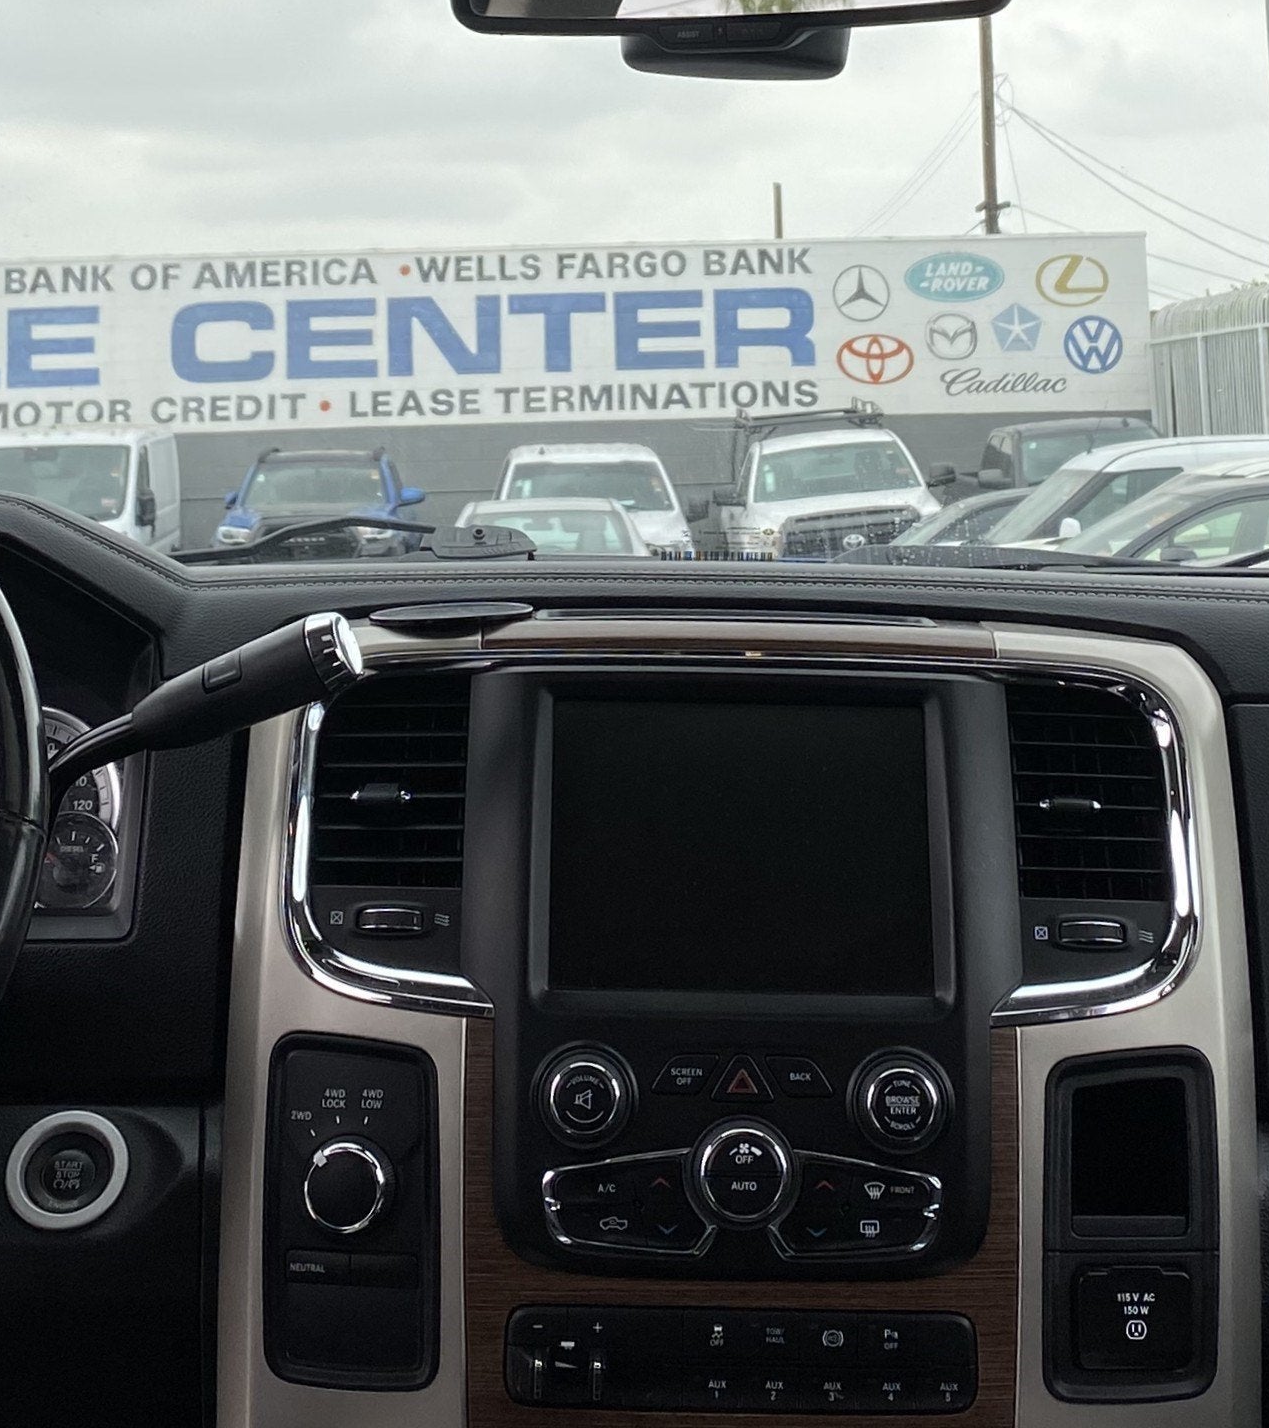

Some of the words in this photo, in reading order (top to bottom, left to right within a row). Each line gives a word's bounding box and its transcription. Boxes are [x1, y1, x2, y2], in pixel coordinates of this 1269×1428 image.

[4, 264, 115, 295] BANK
[130, 262, 183, 292] OF
[192, 257, 379, 292] AMERICA
[415, 252, 542, 285] WELLS
[556, 249, 687, 281] FARGO
[702, 246, 813, 277] BANK
[170, 286, 817, 385] CENTER
[939, 367, 1068, 397] Cadillac
[150, 392, 307, 425] CREDIT
[348, 387, 481, 419] LEASE
[494, 378, 820, 415] TERMINATIONS
[71, 799, 94, 811] 120
[670, 1067, 703, 1077] SCREEN
[789, 1072, 811, 1081] BACK
[570, 1074, 600, 1085] VOLUME
[676, 1077, 693, 1086] OFF
[892, 1080, 911, 1088] TUNE
[324, 1088, 346, 1098] 4WD
[362, 1088, 384, 1099] 4WD
[321, 1098, 346, 1109] LOCK
[361, 1099, 383, 1109] LOW
[885, 1095, 920, 1104] BROWSE
[290, 1110, 312, 1121] 2WD
[890, 1106, 917, 1115] ENTER
[890, 1120, 916, 1131] SCROLL
[735, 1154, 754, 1164] OFF
[54, 1160, 83, 1169] START
[55, 1170, 80, 1179] STOP
[597, 1183, 617, 1193] A/C
[730, 1181, 757, 1191] AUTO
[289, 1262, 326, 1274] NEUTRAL
[1117, 1292, 1131, 1302] 115
[1143, 1292, 1156, 1302] AC
[1124, 1305, 1138, 1315] 150
[1139, 1305, 1150, 1315] W
[883, 1342, 899, 1350] OFF
[708, 1379, 727, 1389] AUX
[765, 1380, 784, 1390] AUX
[823, 1381, 842, 1391] AUX
[882, 1382, 901, 1392] AUX
[939, 1382, 959, 1392] AUX
